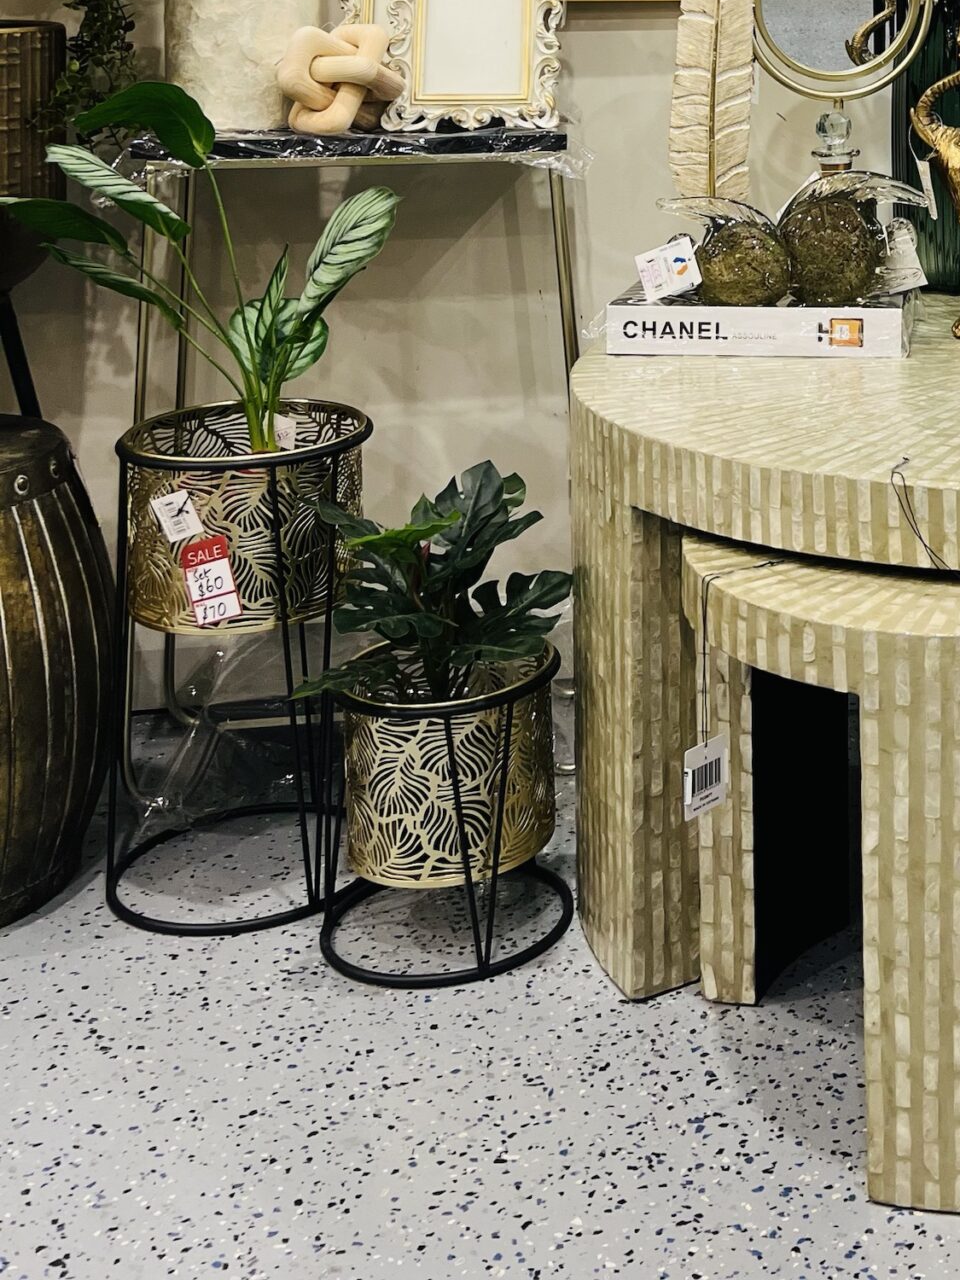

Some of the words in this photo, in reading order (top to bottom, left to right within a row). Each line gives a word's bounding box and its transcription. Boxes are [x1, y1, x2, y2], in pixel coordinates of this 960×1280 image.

[622, 320, 728, 340] CHANEL
[187, 544, 223, 565] SALE
[198, 576, 224, 597] $60
[203, 602, 227, 620] $70
